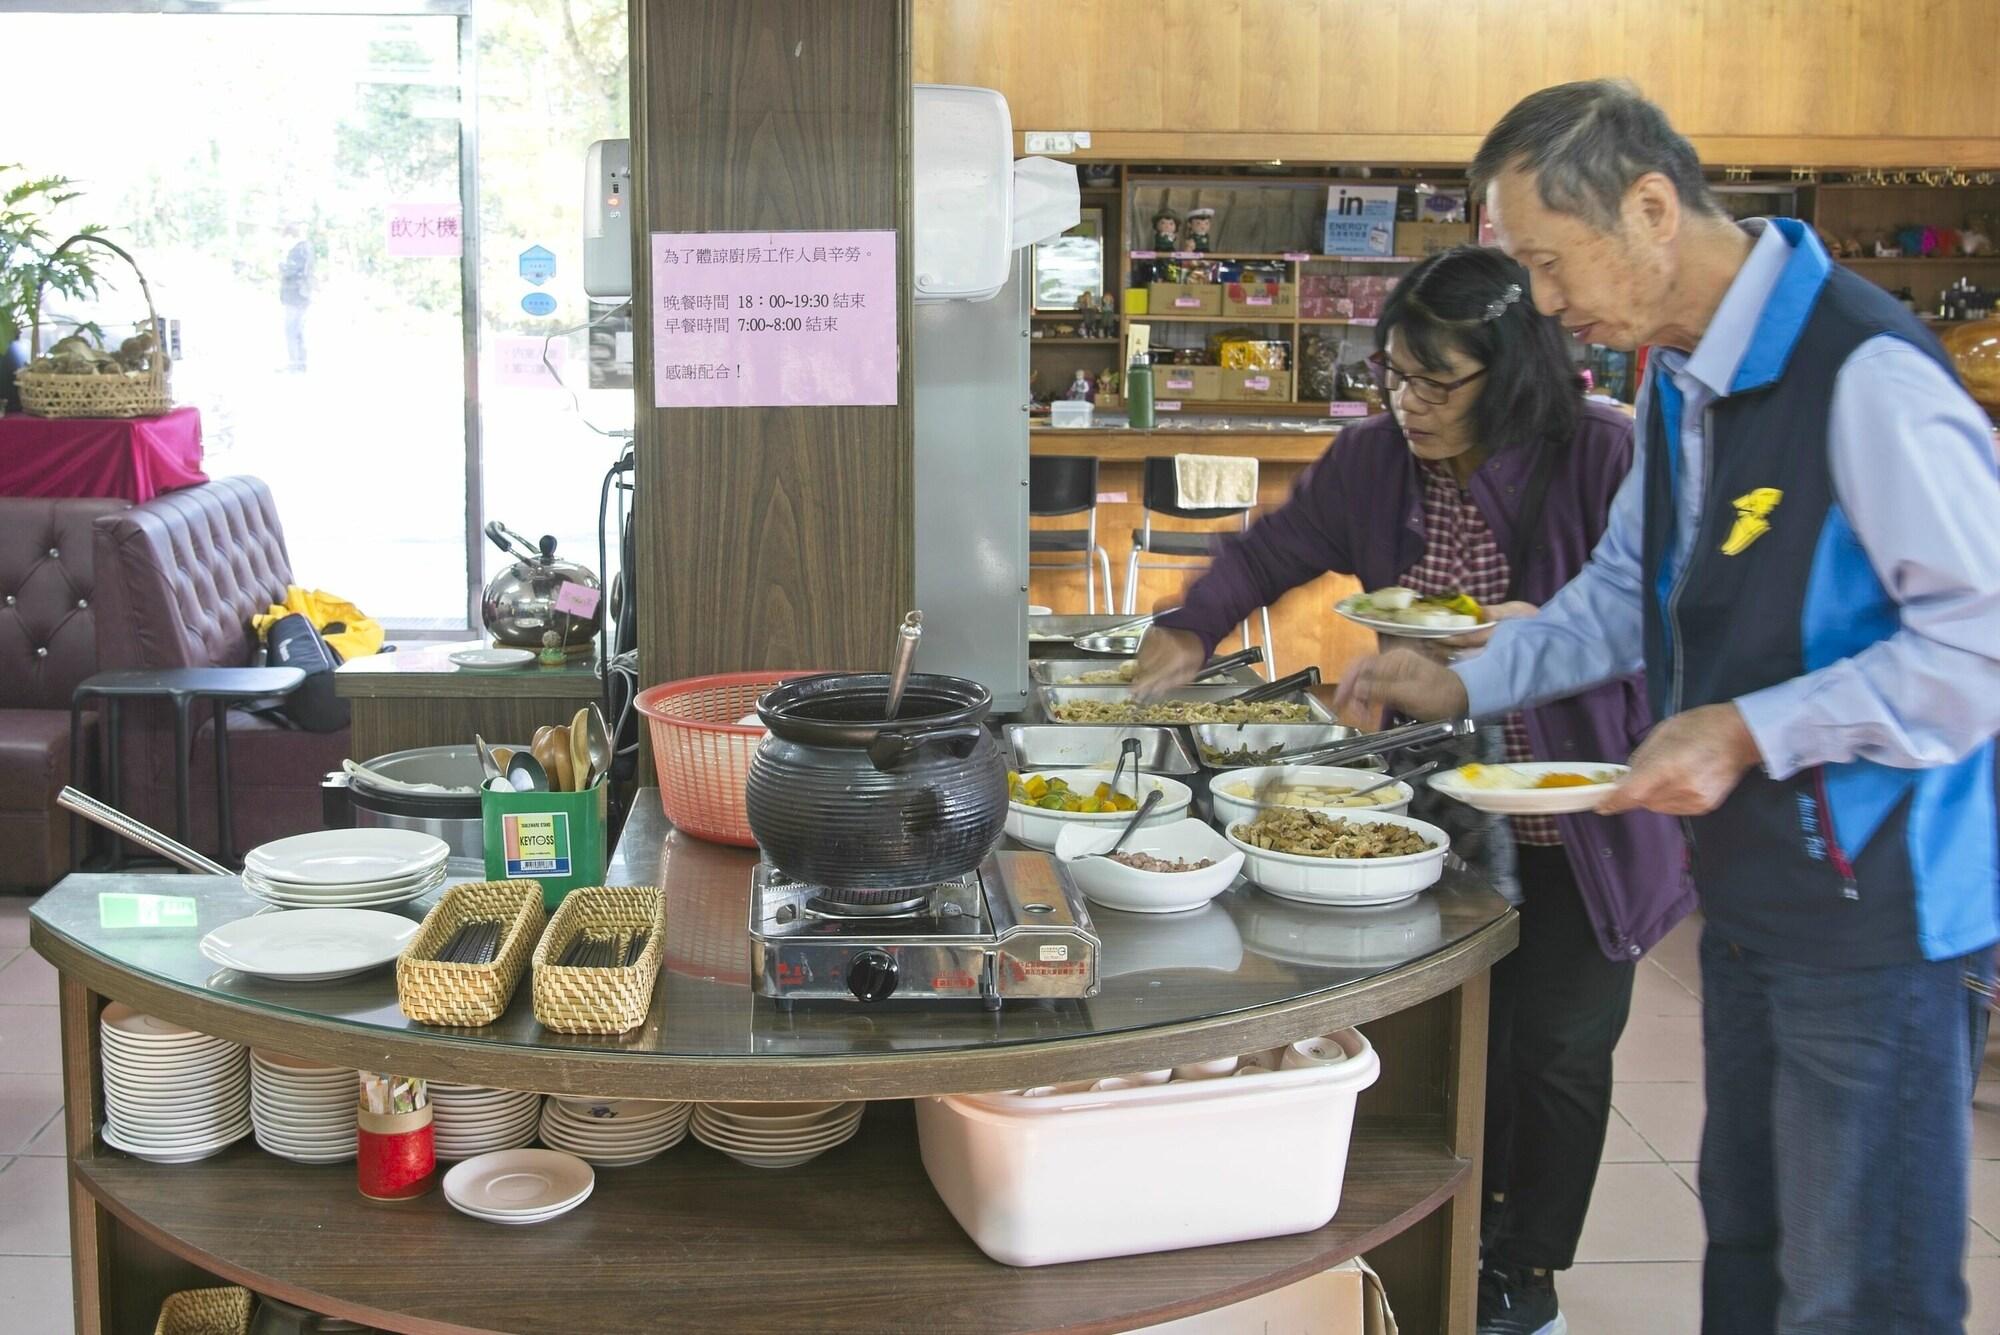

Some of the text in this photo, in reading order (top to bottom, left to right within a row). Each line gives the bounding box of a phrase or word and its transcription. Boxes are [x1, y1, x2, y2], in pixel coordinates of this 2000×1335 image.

[1338, 189, 1363, 216] in
[391, 216, 458, 238] 飲水機
[1329, 222, 1369, 231] ENERGY
[664, 246, 872, 264] 為了體諒廚房工作人員辛勞。
[663, 294, 729, 311] 晚餐時間
[833, 292, 867, 309] 結束
[665, 316, 838, 334] 早餐時間 7:00~8:00 結束
[520, 835, 554, 846] KEYTOSS
